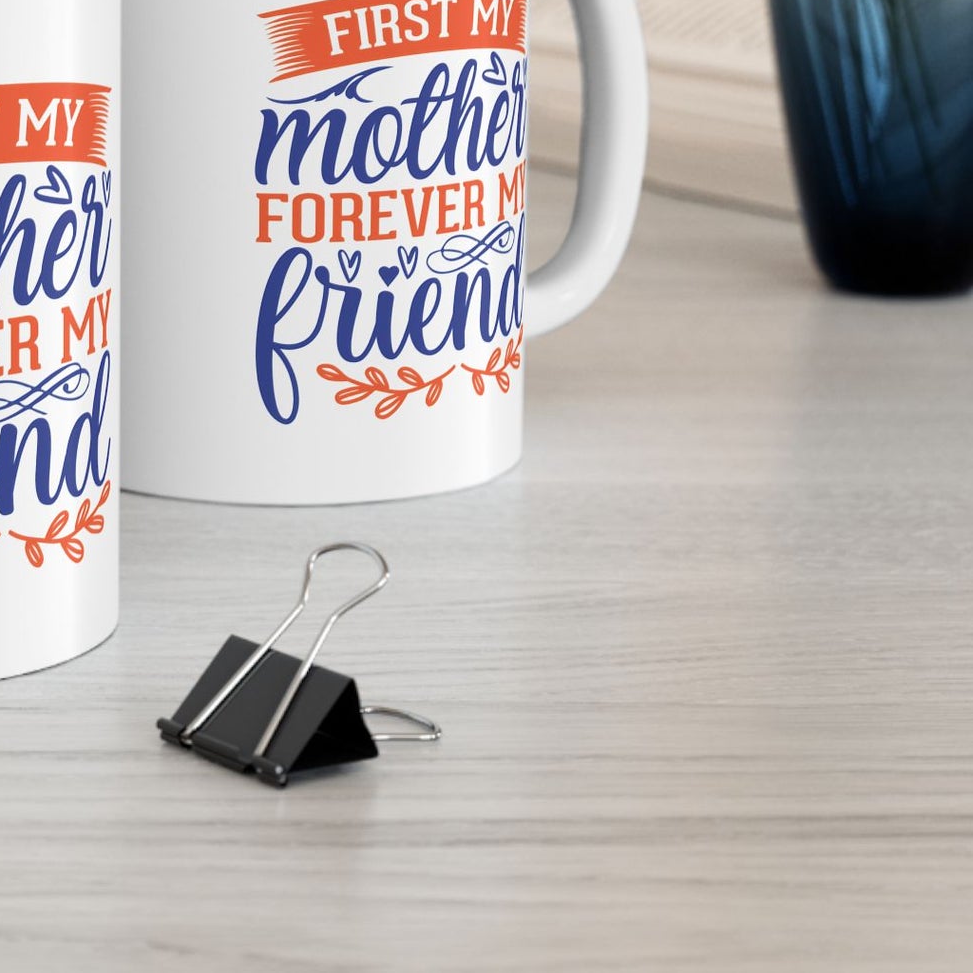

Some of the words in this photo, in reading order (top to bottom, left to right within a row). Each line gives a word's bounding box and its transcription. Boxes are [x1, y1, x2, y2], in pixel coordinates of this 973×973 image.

[16, 98, 84, 147] MY
[254, 58, 527, 185] mother
[256, 179, 485, 243] FOREVER
[498, 159, 527, 222] MY
[61, 288, 112, 364] MY
[255, 211, 525, 424] friend
